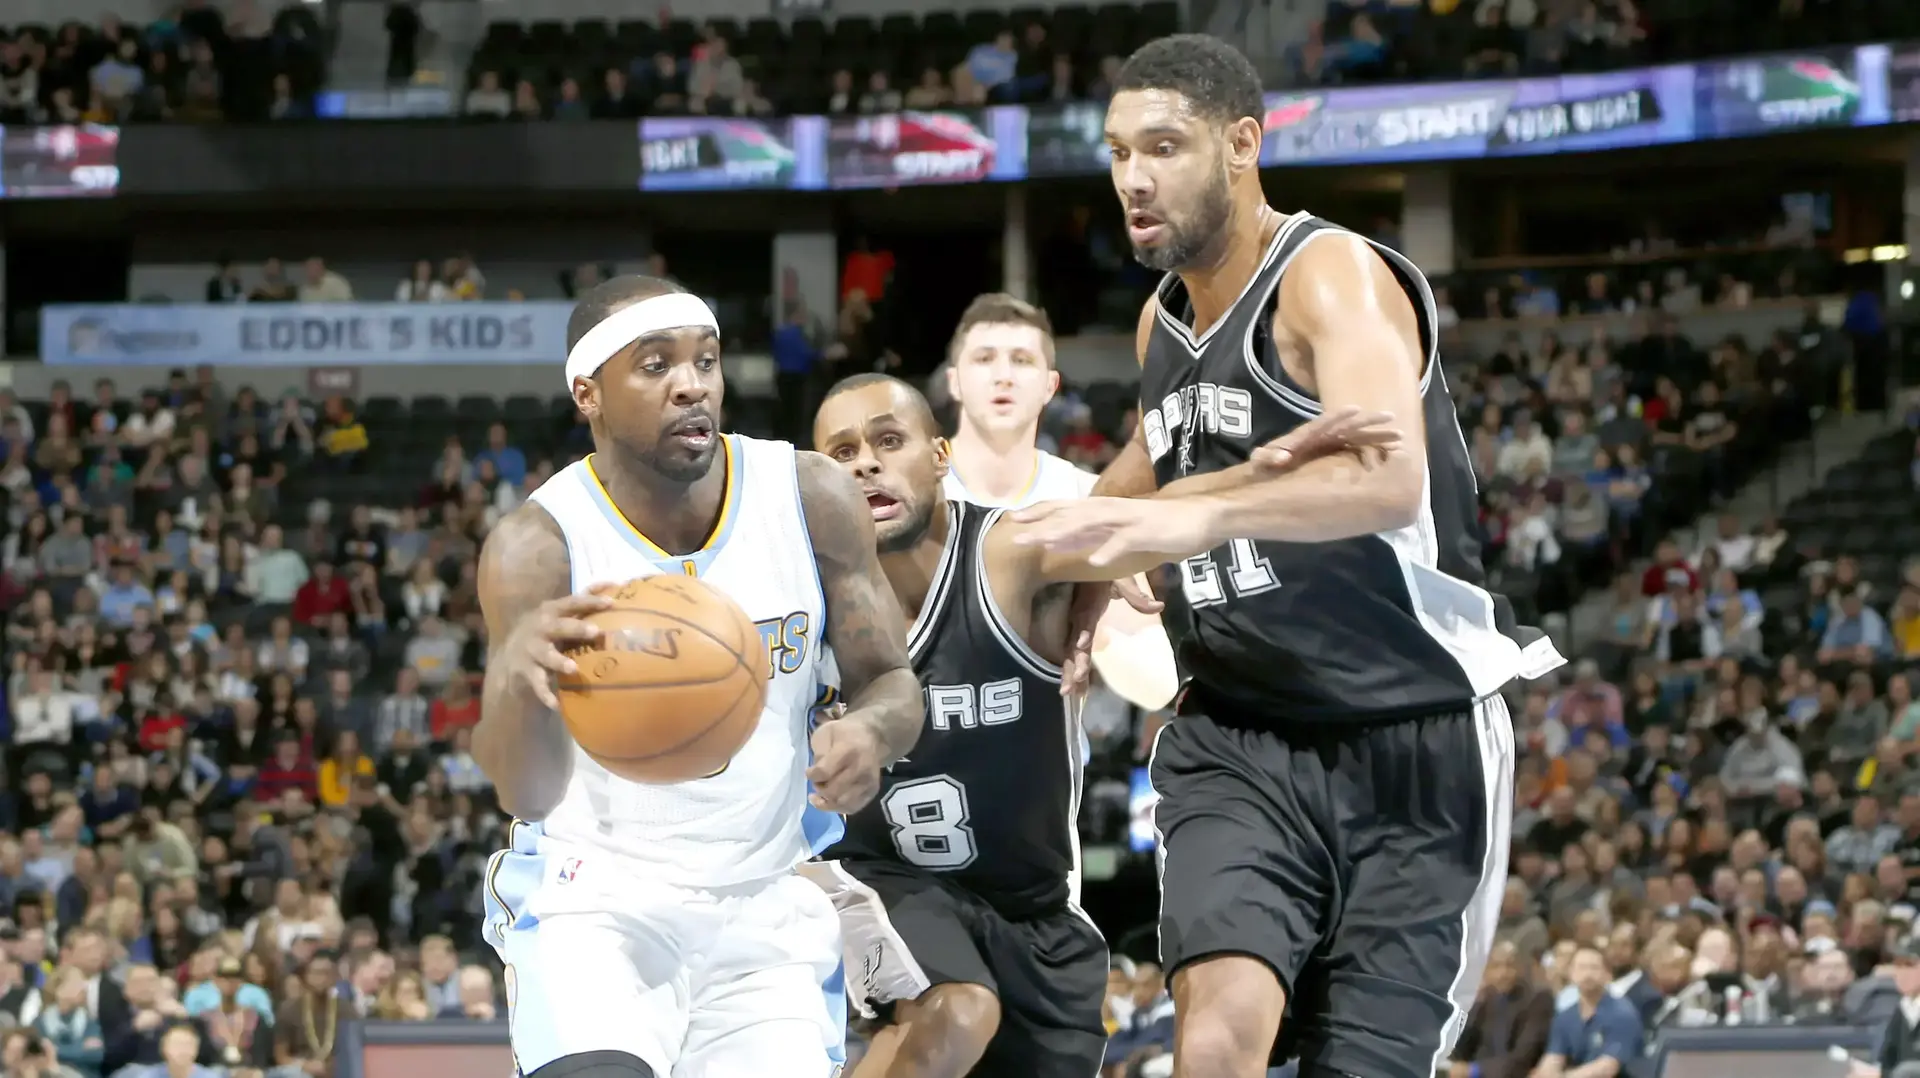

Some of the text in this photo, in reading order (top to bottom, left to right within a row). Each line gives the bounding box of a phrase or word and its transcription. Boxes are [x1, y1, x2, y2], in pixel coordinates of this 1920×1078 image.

[429, 313, 535, 349] KIDS
[924, 677, 1023, 730] RS
[880, 773, 979, 871] 8
